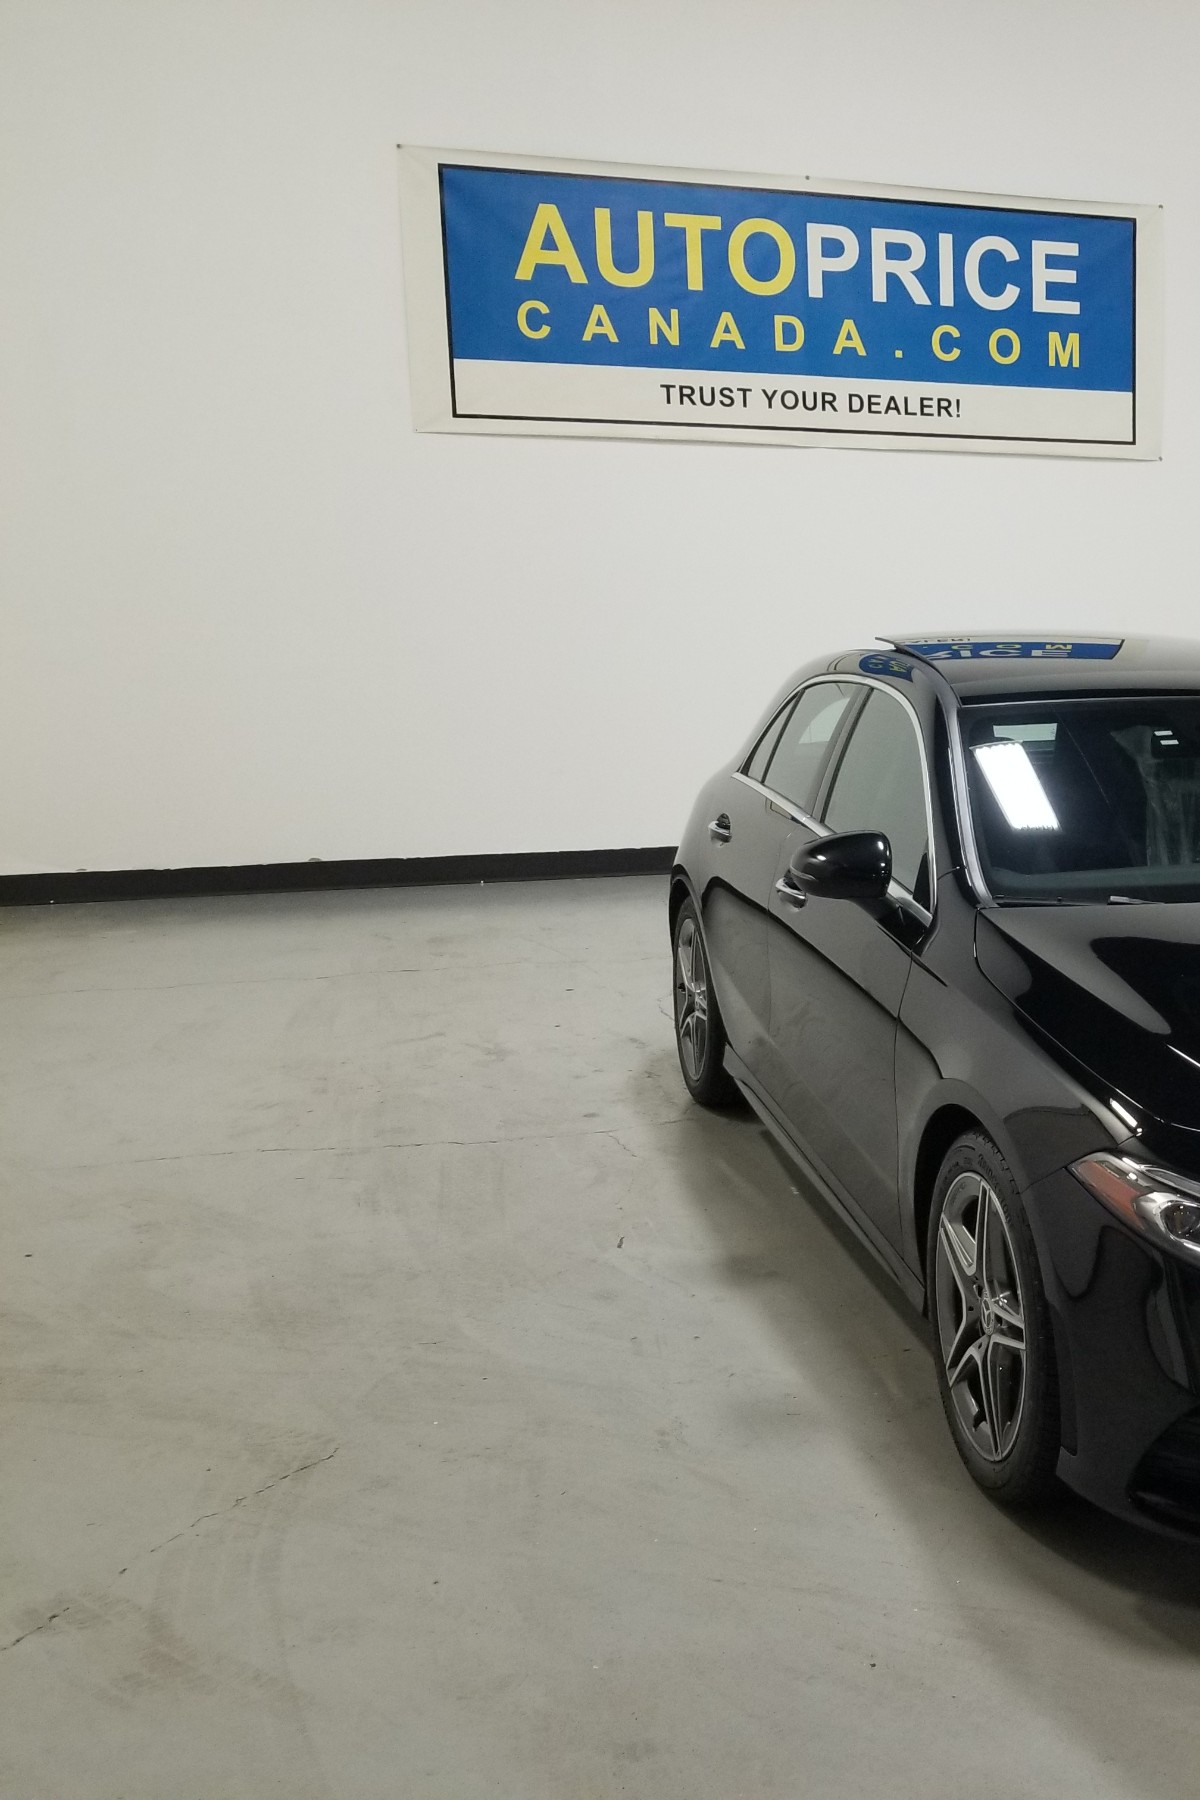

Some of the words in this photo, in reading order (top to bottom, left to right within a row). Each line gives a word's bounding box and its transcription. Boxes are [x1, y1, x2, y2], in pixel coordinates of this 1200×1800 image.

[514, 203, 1081, 315] AUTOPRICE
[516, 300, 1080, 368] CANADA.COM
[660, 384, 752, 408] TRUST
[761, 389, 838, 413] YOUR
[848, 393, 961, 418] DEALER!
